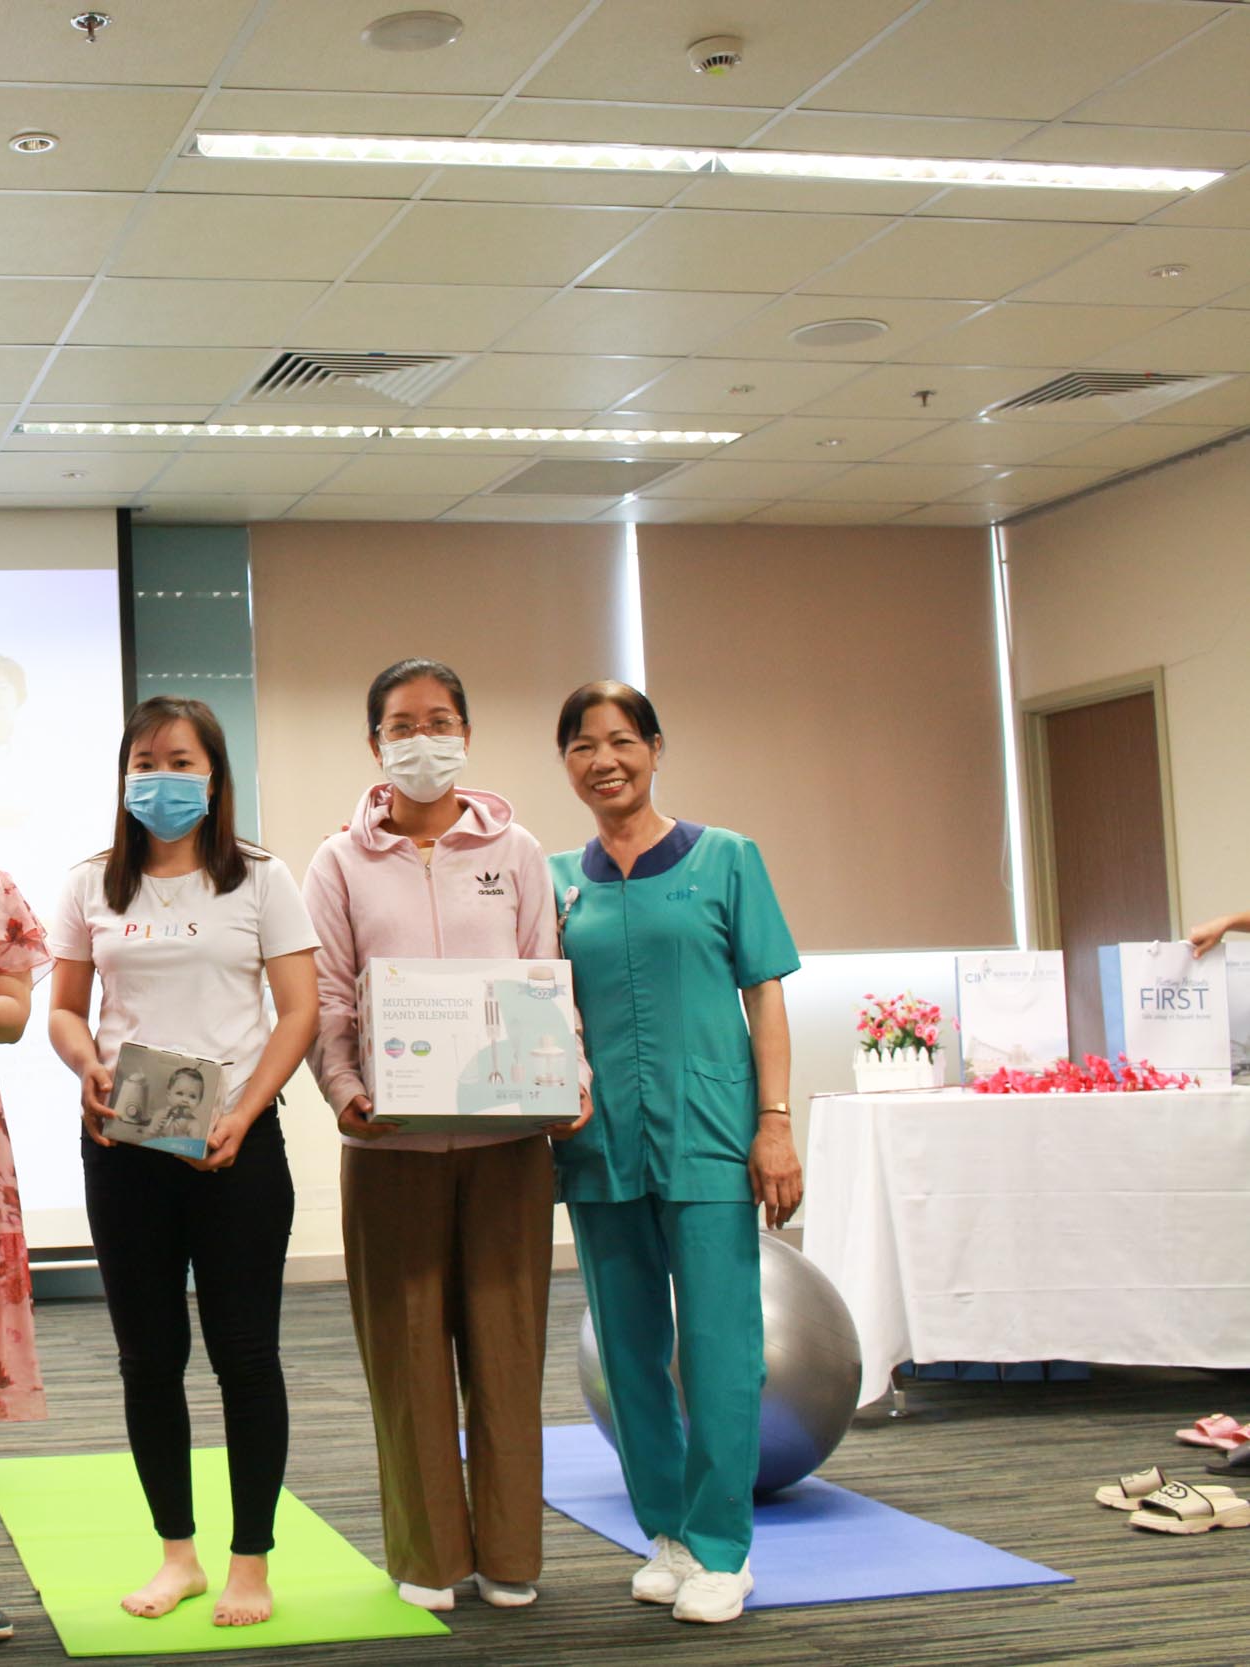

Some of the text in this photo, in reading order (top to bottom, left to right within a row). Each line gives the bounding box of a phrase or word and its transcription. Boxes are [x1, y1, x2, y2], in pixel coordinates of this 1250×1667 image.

[124, 923, 198, 938] PLUS
[1140, 988, 1209, 1010] FIRST
[382, 1010, 416, 1020] HAND
